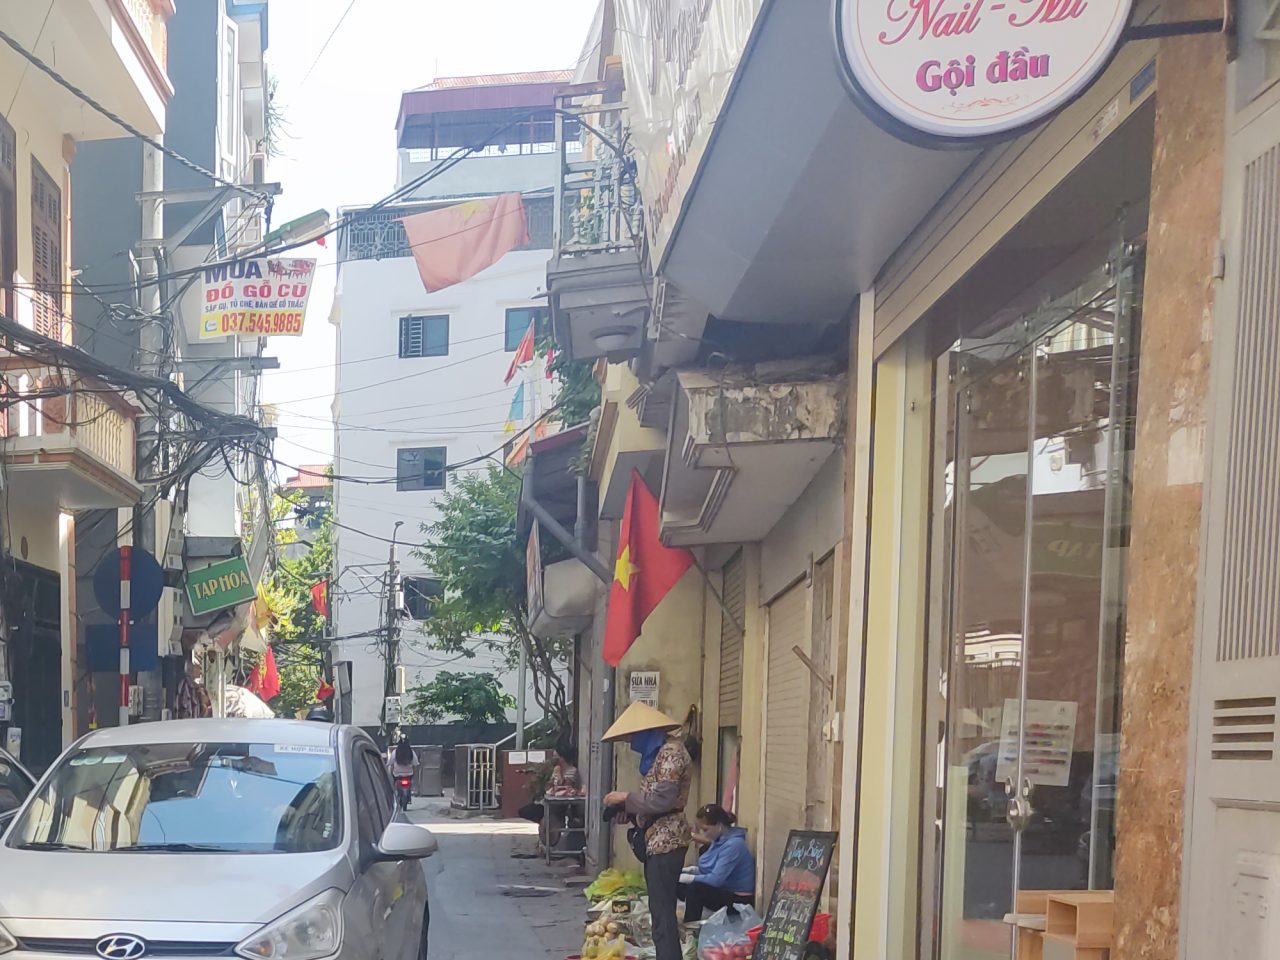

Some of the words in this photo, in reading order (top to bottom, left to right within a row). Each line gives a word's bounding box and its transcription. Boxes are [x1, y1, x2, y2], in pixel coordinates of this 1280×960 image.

[879, 0, 982, 45] Nail
[916, 55, 976, 96] Gội
[986, 46, 1050, 84] đầu
[205, 261, 262, 284] MUA
[243, 280, 272, 298] GỖ
[278, 282, 307, 298] CŨ
[221, 312, 302, 333] 037.545.9885
[193, 580, 218, 600] TẠP
[219, 569, 249, 592] HÓA
